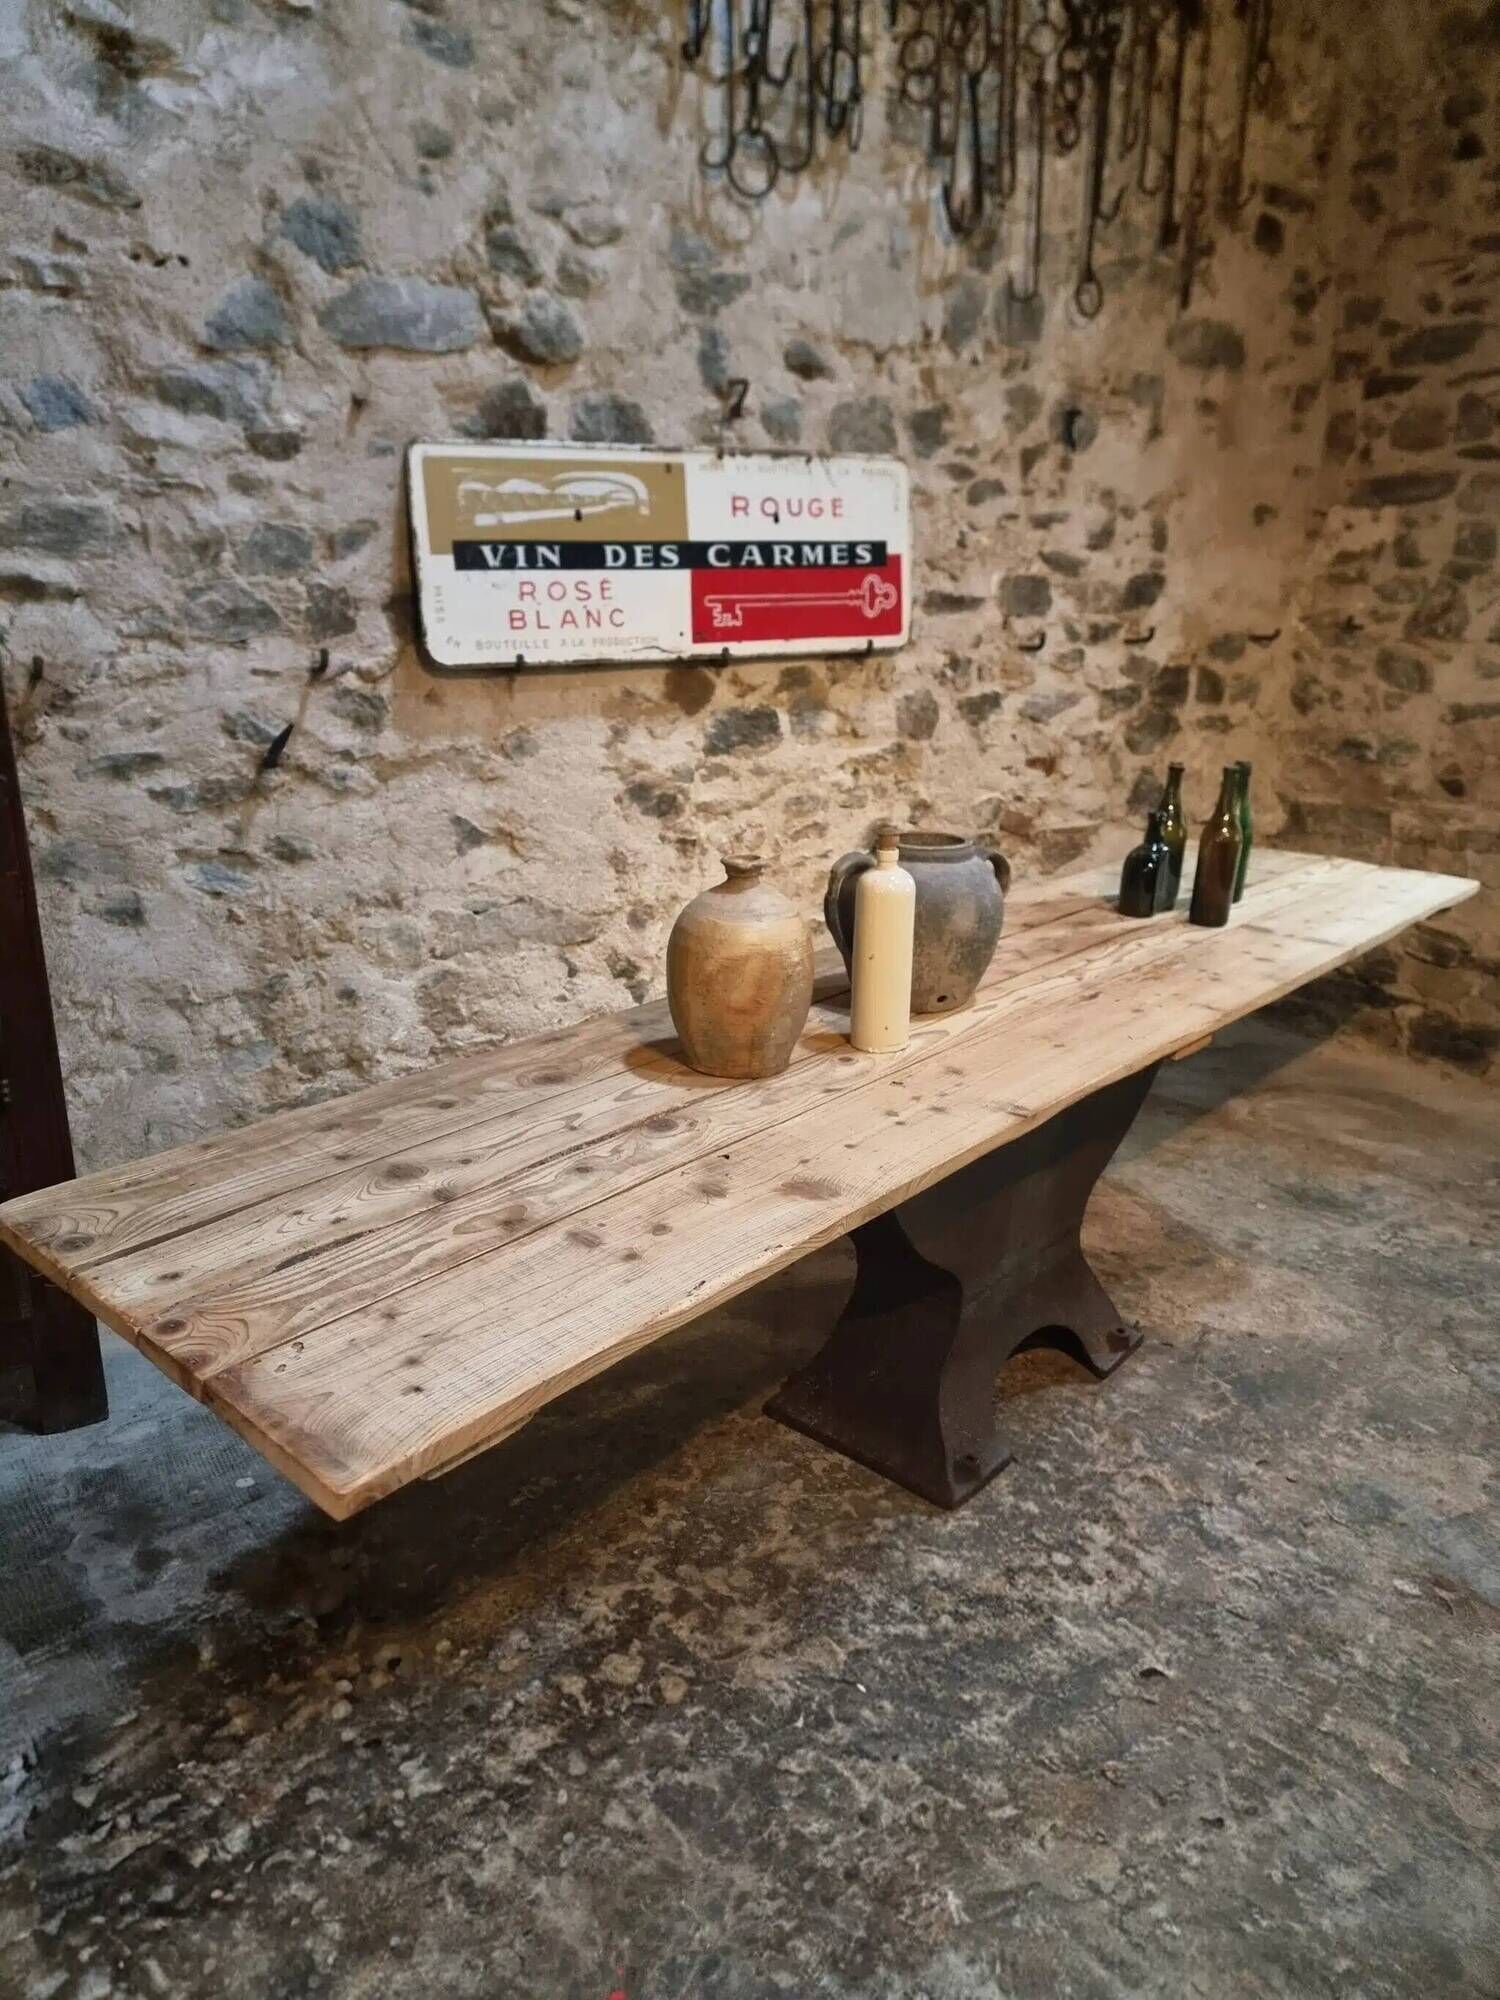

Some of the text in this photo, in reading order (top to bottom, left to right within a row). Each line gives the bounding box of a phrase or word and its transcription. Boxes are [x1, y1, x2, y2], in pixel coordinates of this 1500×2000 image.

[731, 496, 844, 518] ROUGE
[478, 544, 873, 568] VIN DES CARMES
[518, 577, 613, 601] ROSÉ
[509, 608, 625, 630] BLANC
[475, 639, 549, 651] BOUTEILLE
